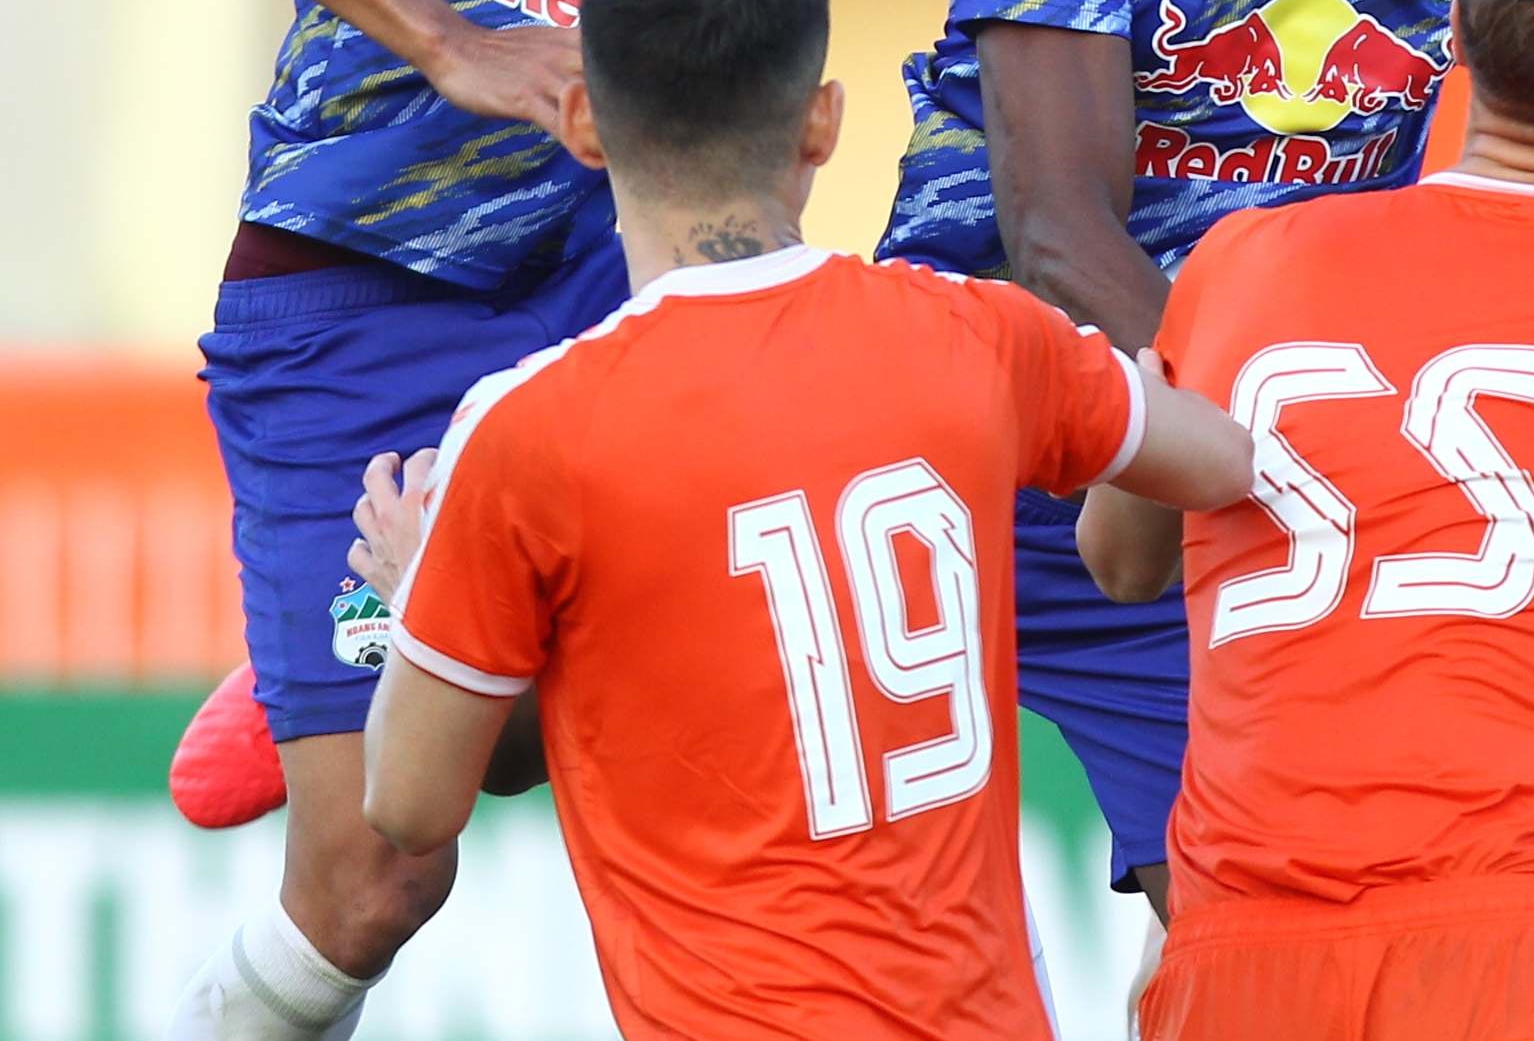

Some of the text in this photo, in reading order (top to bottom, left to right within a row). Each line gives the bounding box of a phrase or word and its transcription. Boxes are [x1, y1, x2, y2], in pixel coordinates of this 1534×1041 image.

[1134, 119, 1399, 187] Red Bull
[727, 455, 994, 841] 19
